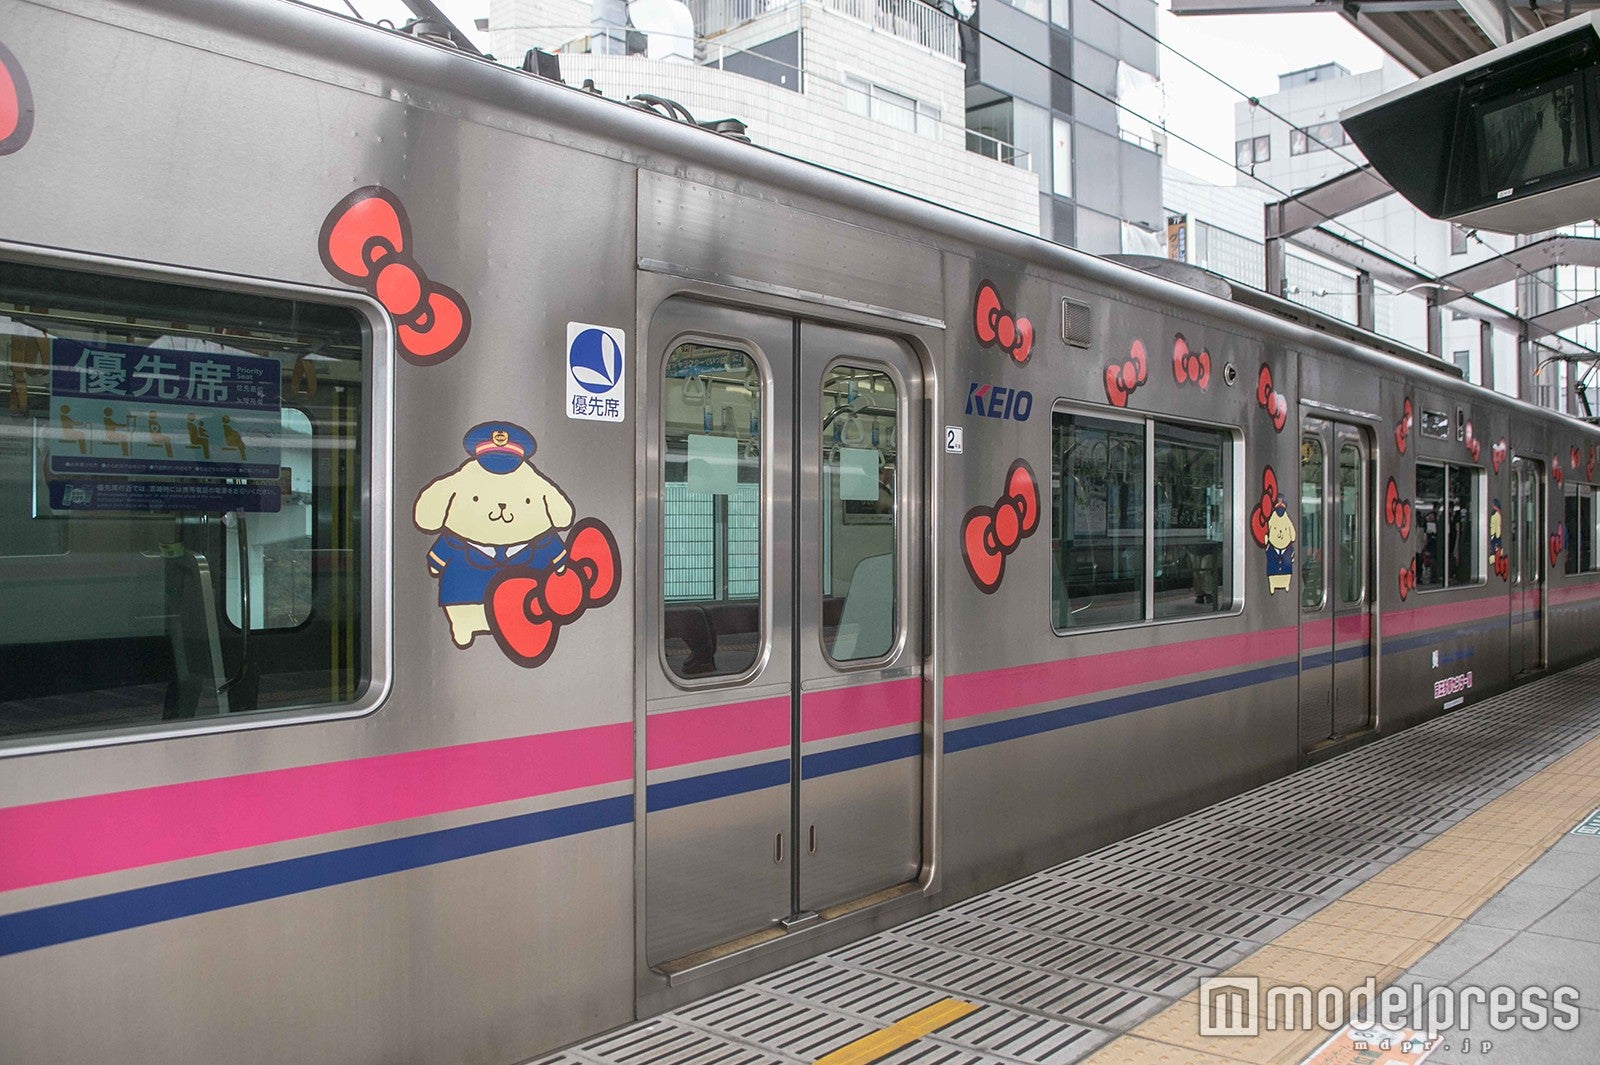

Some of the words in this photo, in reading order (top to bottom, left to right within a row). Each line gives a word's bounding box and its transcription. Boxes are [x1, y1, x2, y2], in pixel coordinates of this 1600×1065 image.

[74, 348, 232, 403] 優先席
[236, 366, 264, 377] Priority
[236, 373, 254, 381] Seat
[571, 394, 620, 418] 優先席
[965, 382, 1033, 422] KEIO
[947, 430, 955, 449] 2
